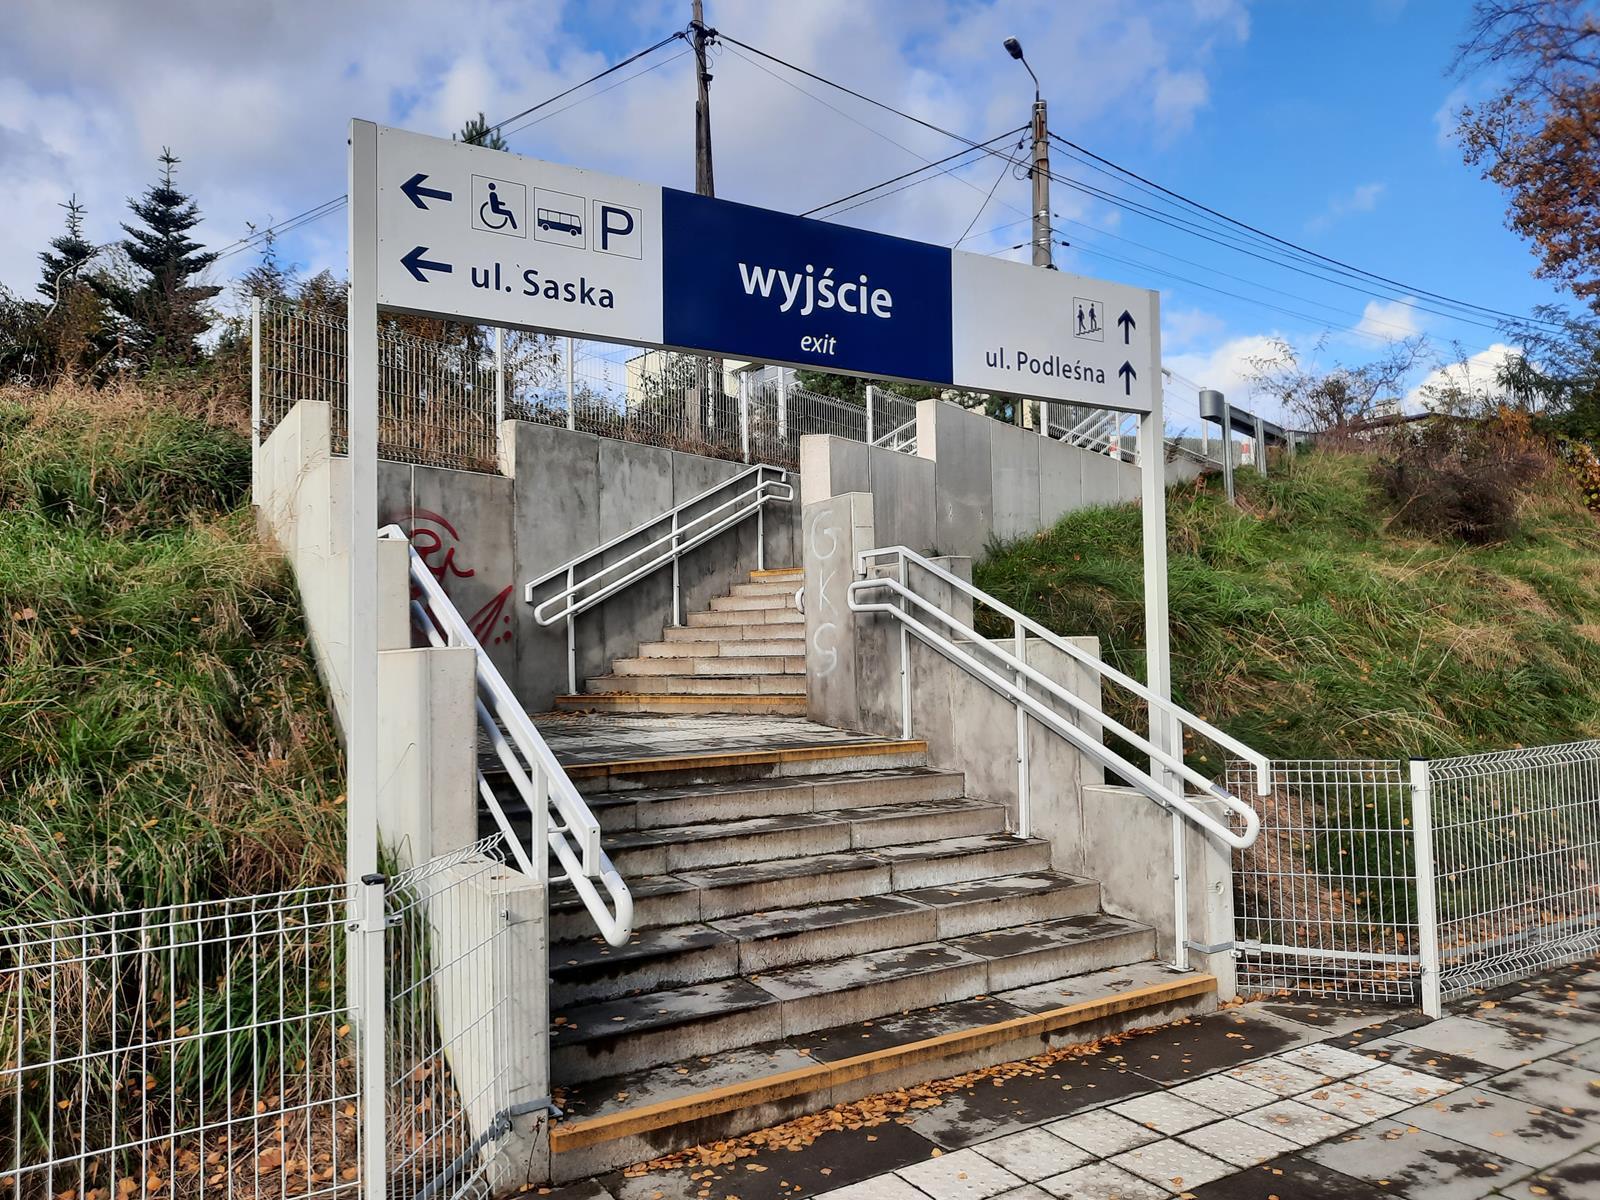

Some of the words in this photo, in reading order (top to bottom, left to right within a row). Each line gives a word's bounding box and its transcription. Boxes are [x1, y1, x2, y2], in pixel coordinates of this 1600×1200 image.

[601, 205, 634, 250] P
[471, 262, 512, 293] ul.
[523, 269, 614, 309] Saska
[738, 262, 893, 319] wyjście
[800, 333, 837, 355] exit
[986, 347, 1011, 370] ul.
[1017, 351, 1105, 384] Podleśna
